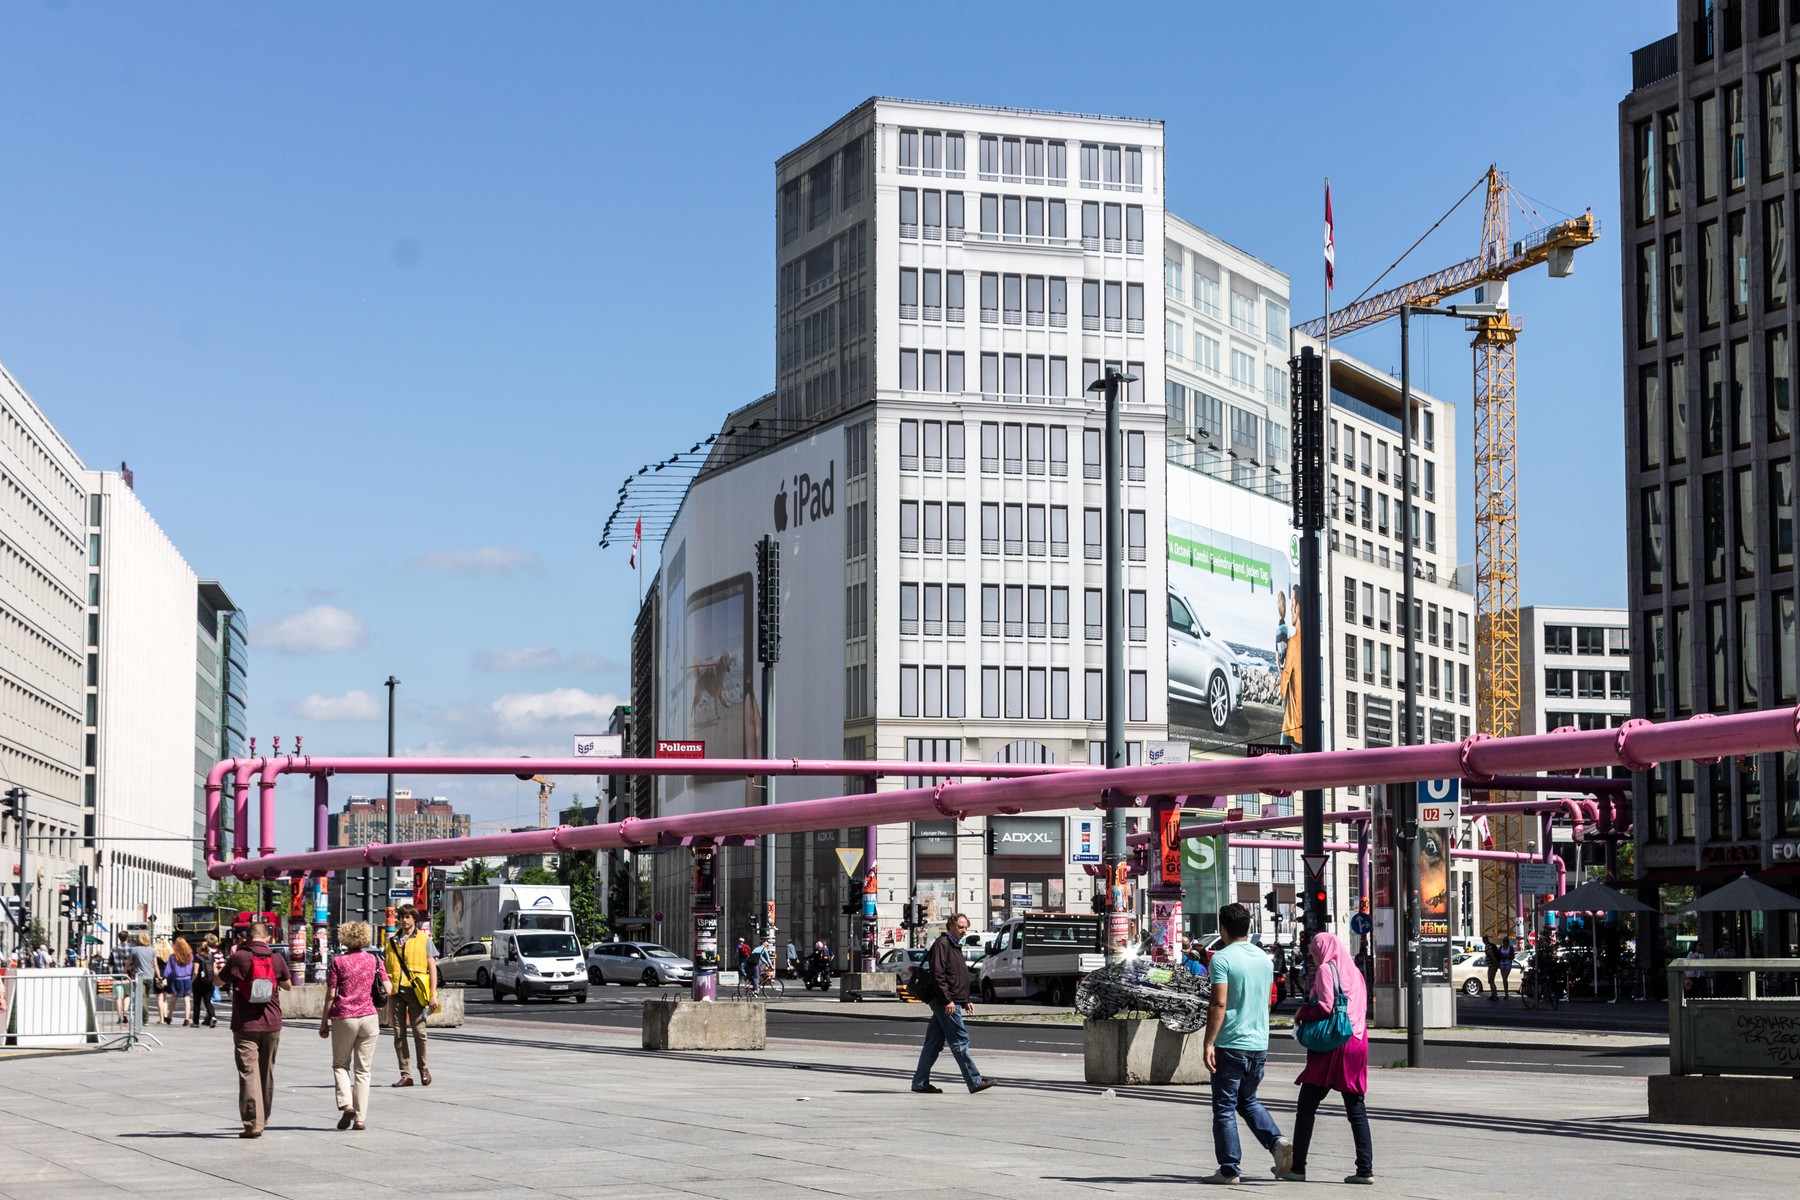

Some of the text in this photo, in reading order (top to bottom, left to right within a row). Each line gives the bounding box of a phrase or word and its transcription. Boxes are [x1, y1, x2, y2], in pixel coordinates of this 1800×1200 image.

[794, 460, 834, 528] iPad
[1246, 564, 1259, 579] Jeden
[659, 743, 702, 752] Pollems
[1250, 746, 1288, 756] Pollems
[1428, 778, 1450, 799] U
[1424, 809, 1438, 820] U2
[1187, 836, 1215, 870] S
[1772, 843, 1800, 860] FO
